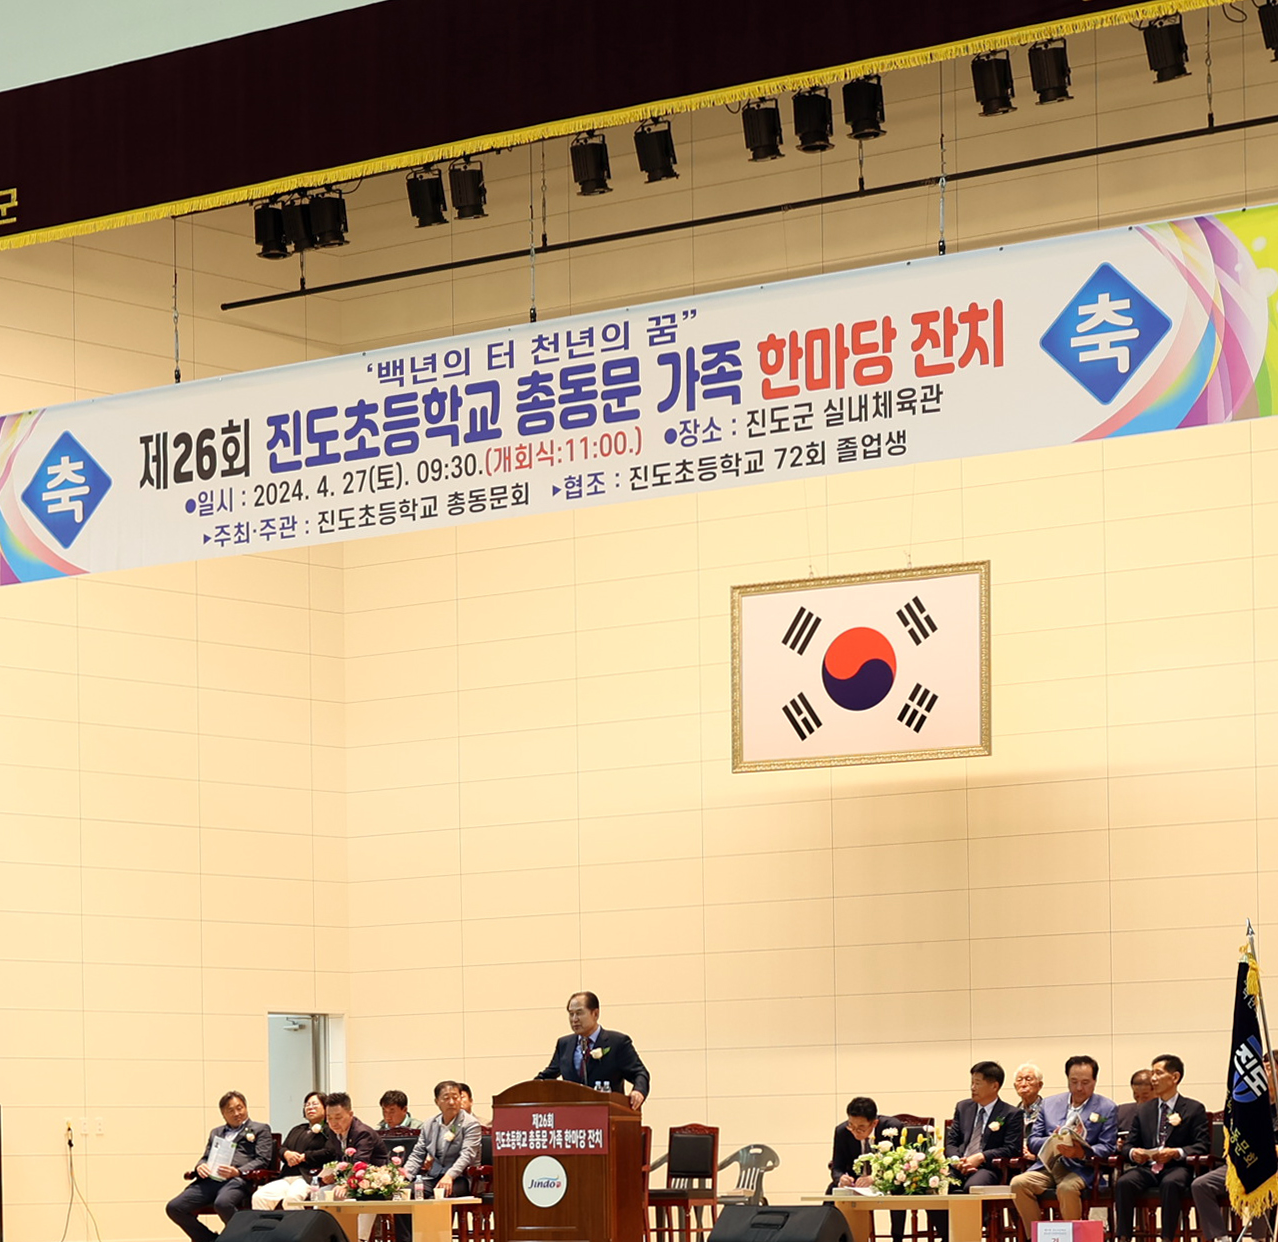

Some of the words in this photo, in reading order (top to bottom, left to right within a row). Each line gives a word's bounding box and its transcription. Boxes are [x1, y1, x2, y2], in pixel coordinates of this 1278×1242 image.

[487, 339, 515, 372] 터
[530, 320, 630, 366] 천년의
[1071, 293, 1140, 374] 축
[139, 418, 251, 490] 제26회
[266, 379, 503, 475] 진도초등학교
[515, 356, 642, 437] 총동문
[657, 339, 743, 414] 가족
[757, 315, 898, 401] 한마당
[910, 298, 1005, 378] 잔치
[198, 487, 234, 517] 일시
[253, 479, 310, 508] 2024.
[316, 475, 335, 498] 4.
[342, 461, 410, 495] 27(토).
[678, 415, 723, 449] 장소
[746, 401, 815, 439] 진도군
[823, 383, 944, 429] 실내체육관
[41, 455, 90, 525] 축
[317, 494, 439, 535] 진도초등학교
[446, 482, 530, 517] 총동문회
[564, 471, 606, 500] 협조
[629, 450, 765, 491] 진도초등학교
[774, 439, 826, 471] 72회
[836, 429, 907, 464] 졸업생
[1234, 1043, 1269, 1098] 진도
[495, 1130, 528, 1150] 진도초등학교
[528, 1130, 548, 1149] 총동문
[549, 1129, 563, 1149] 가족
[564, 1129, 587, 1149] 한마당
[587, 1128, 603, 1149] 잔치
[532, 1113, 554, 1129] 제26회
[528, 1179, 556, 1190] Jindo
